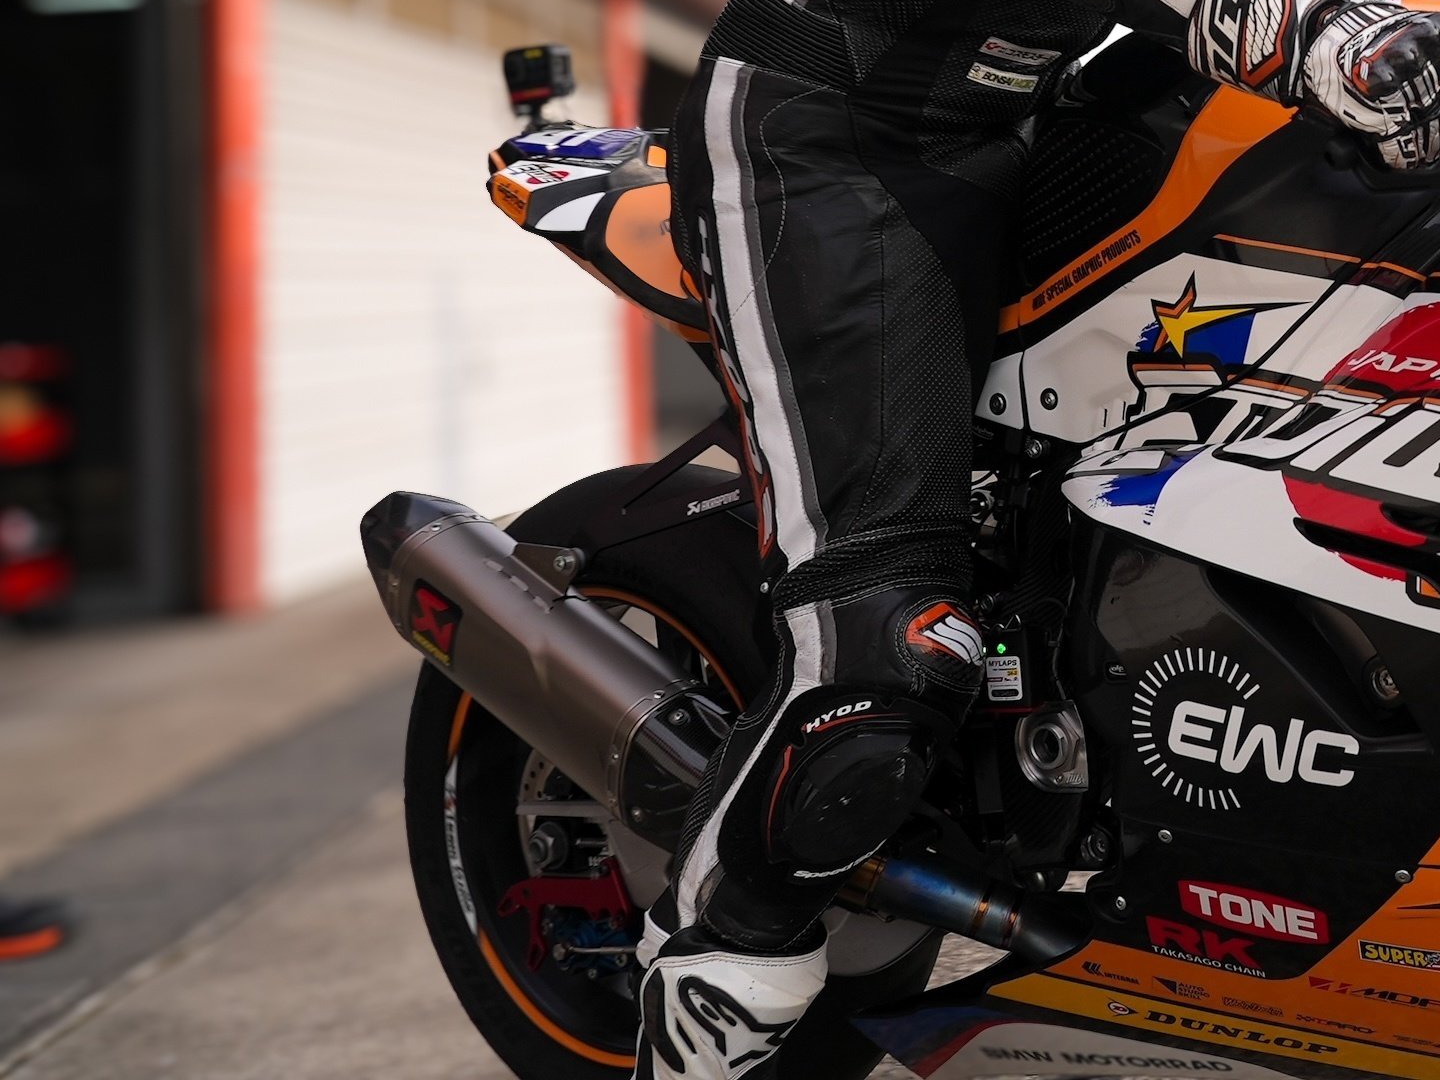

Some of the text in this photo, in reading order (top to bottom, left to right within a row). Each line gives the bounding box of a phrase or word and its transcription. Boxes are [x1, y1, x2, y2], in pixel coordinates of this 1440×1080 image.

[1046, 273, 1074, 301] SPECIAL
[1072, 254, 1103, 283] GRAPHIC
[1101, 229, 1141, 265] PRODUCTS
[806, 701, 872, 733] HYOD
[1168, 700, 1360, 787] EWC
[1189, 884, 1318, 940] TONE
[1146, 916, 1262, 969] RK
[1152, 945, 1266, 979] TAKASAGO CHAIN
[1365, 944, 1427, 967] SUPER
[1145, 1010, 1338, 1054] DUNLOP
[979, 1046, 1233, 1072] BMW MOTORRAD
